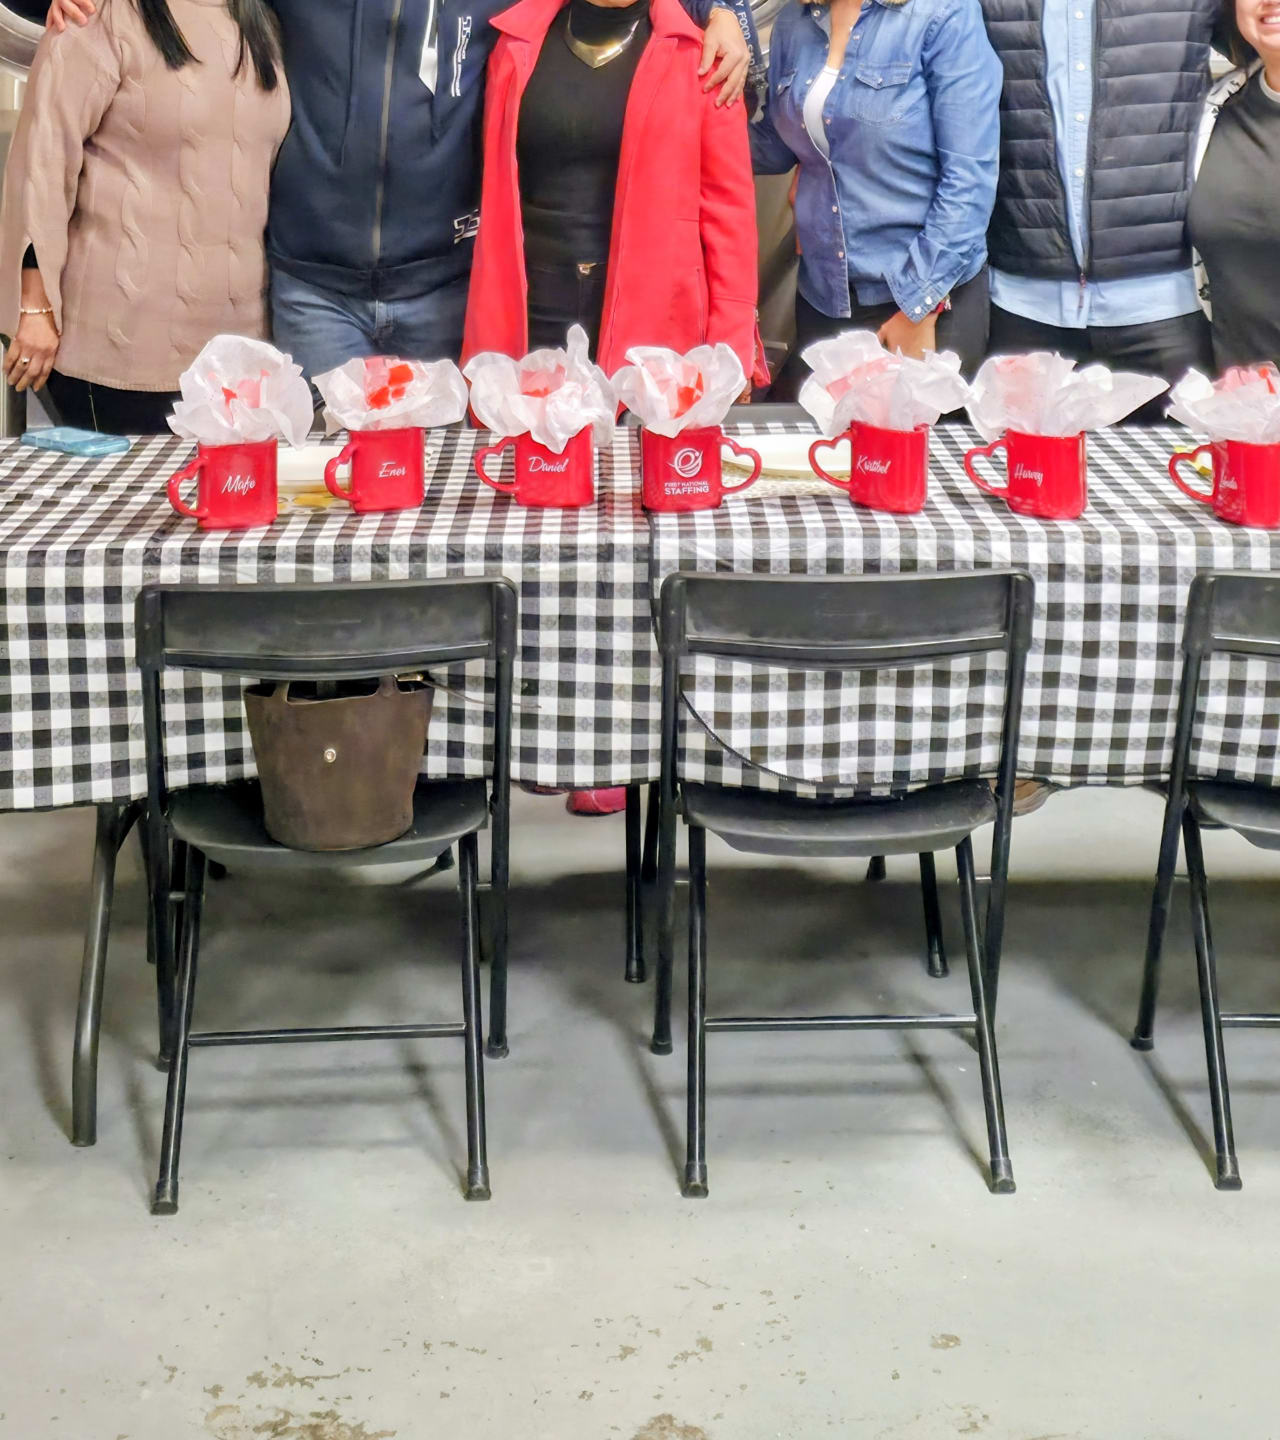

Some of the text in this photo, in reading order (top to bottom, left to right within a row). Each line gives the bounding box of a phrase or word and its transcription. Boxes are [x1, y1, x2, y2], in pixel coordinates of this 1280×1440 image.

[737, 11, 751, 41] FOOD
[528, 456, 569, 472] Daniel
[664, 485, 710, 496] STAFFING
